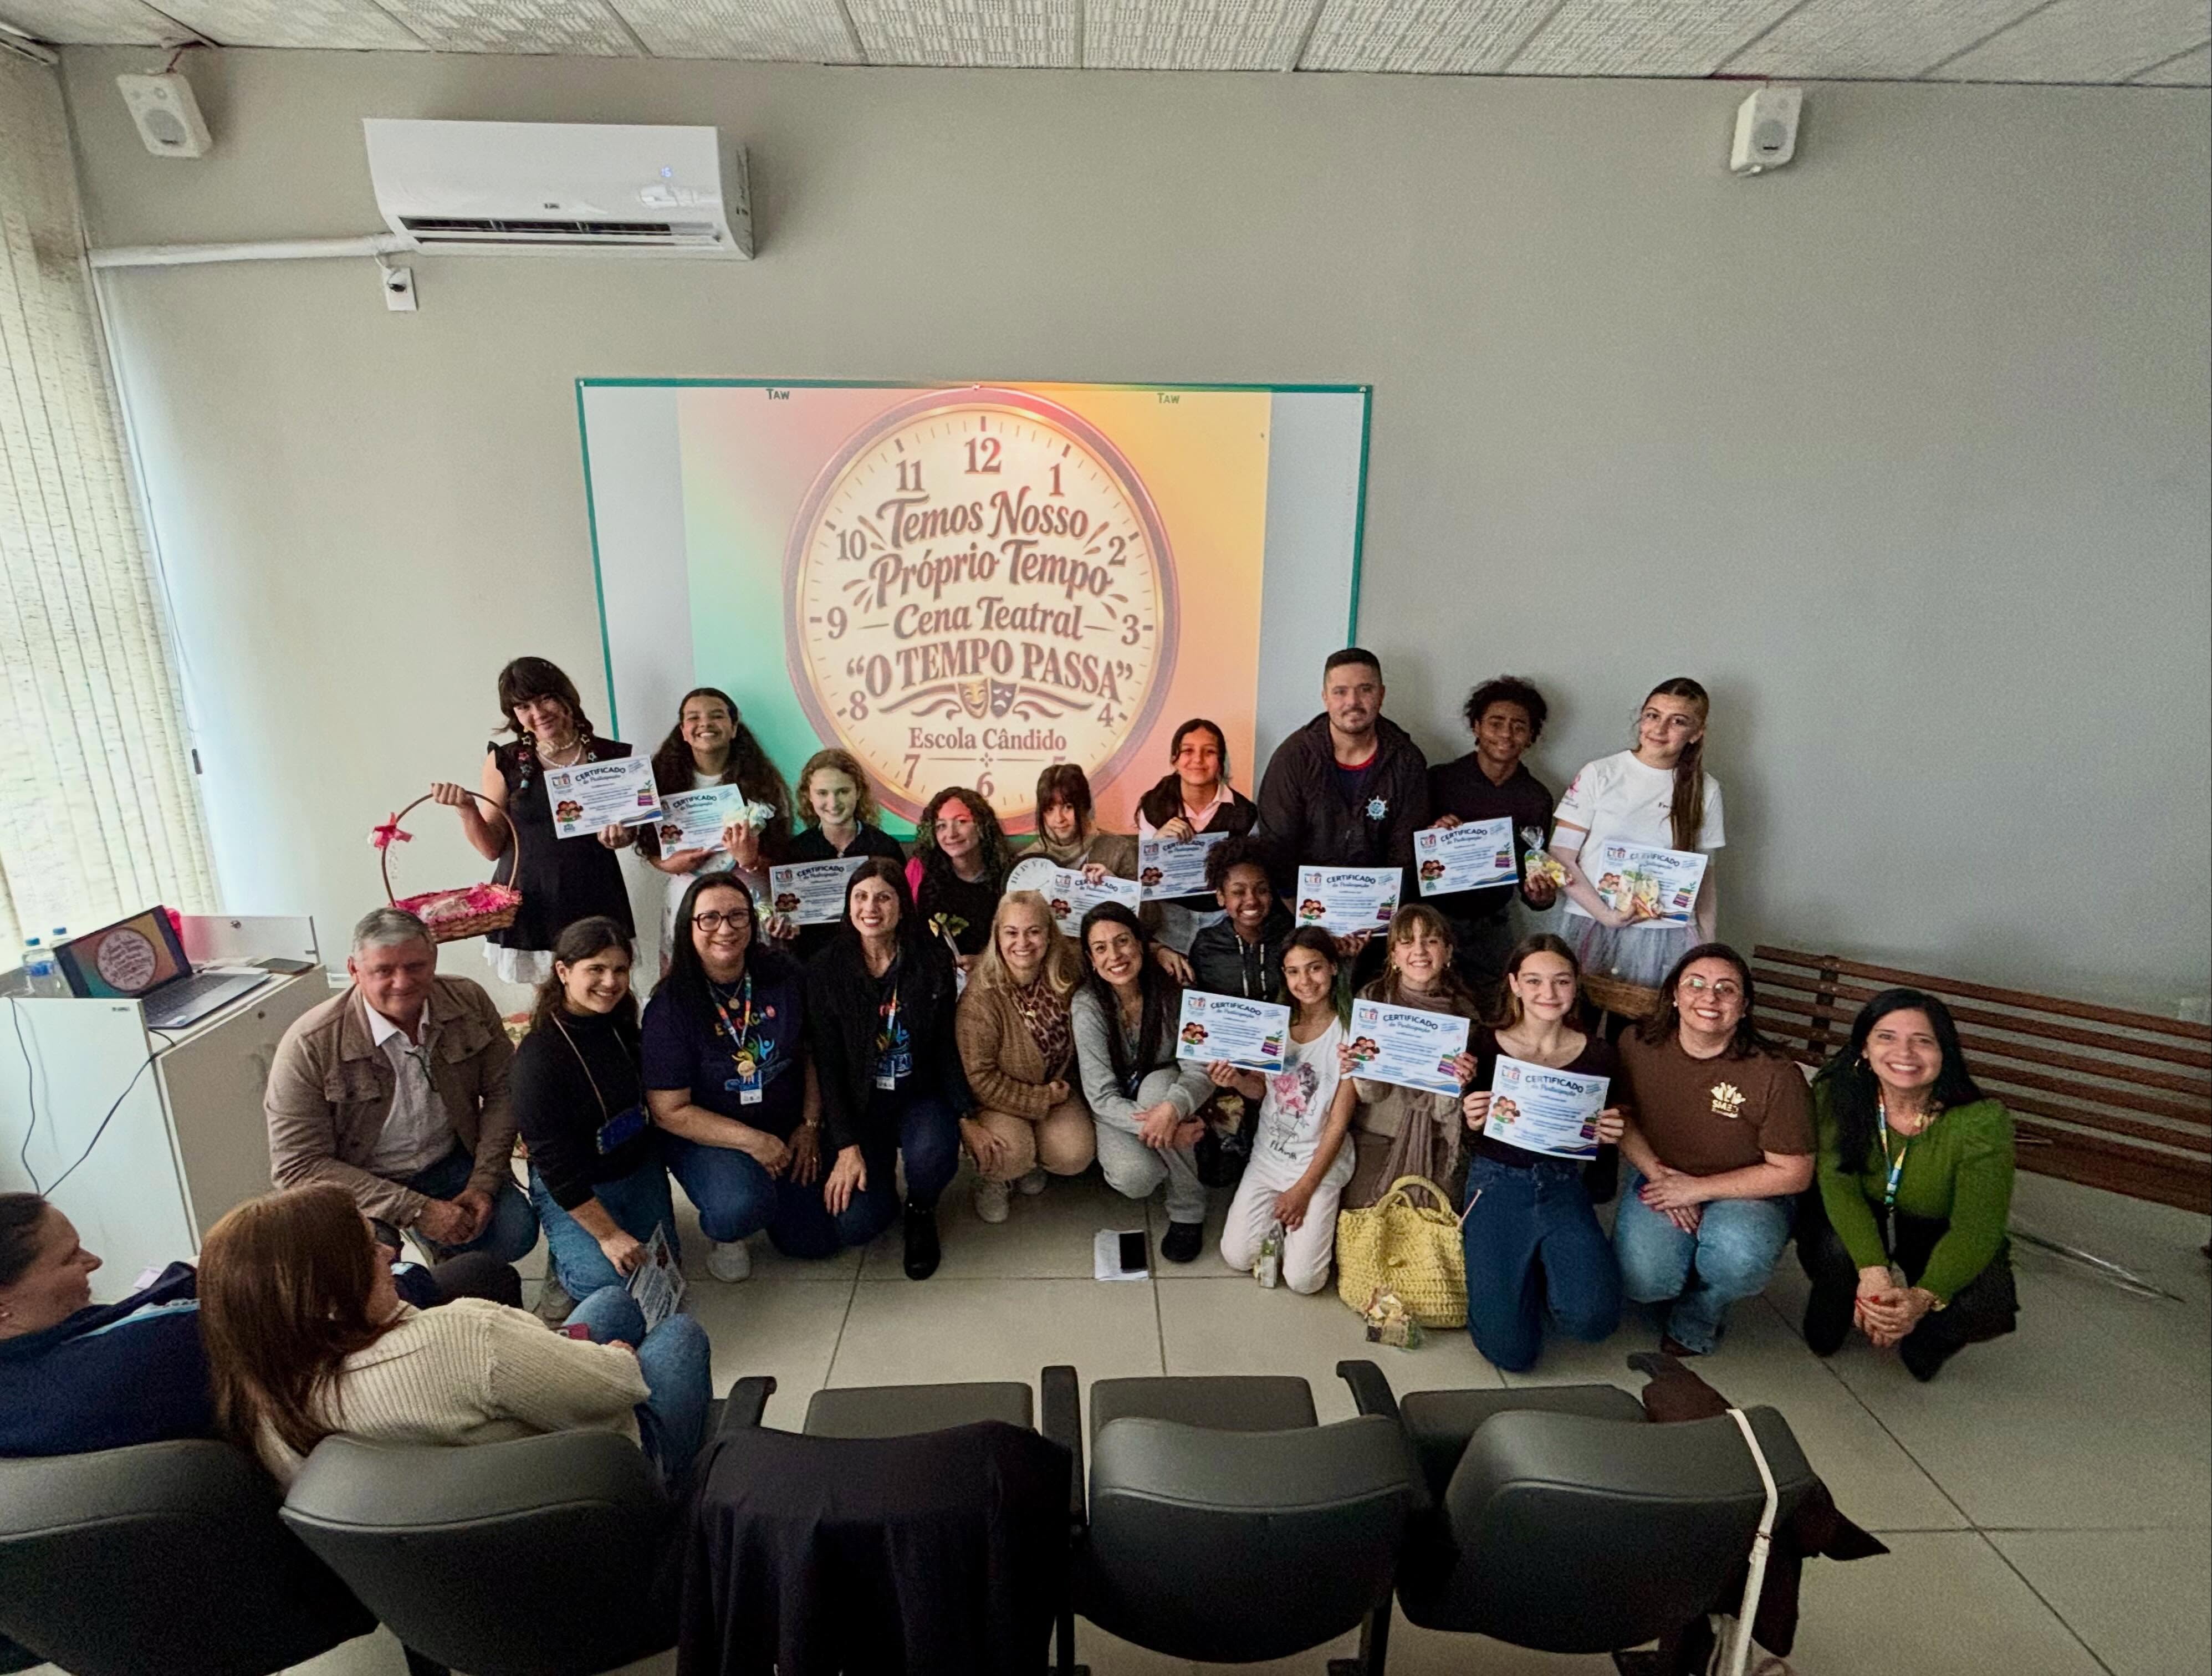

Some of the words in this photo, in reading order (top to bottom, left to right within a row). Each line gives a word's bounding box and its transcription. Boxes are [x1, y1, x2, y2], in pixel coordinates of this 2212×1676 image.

[964, 437, 1002, 474] 12
[896, 460, 926, 492] 11
[1049, 463, 1065, 497] 1
[876, 493, 983, 549] Temos
[987, 486, 1088, 539] Nosso
[836, 529, 867, 561] 10
[1108, 536, 1126, 566] 2
[869, 541, 1000, 609] Próprio
[1000, 539, 1114, 601] Tempo
[827, 606, 847, 639] 9
[893, 604, 972, 640] Cena
[977, 596, 1084, 641] Teatral
[1121, 614, 1140, 645] 3
[896, 638, 1014, 690] TEMPO
[1021, 642, 1133, 704] PASSA”
[849, 691, 869, 721] 8
[1097, 703, 1113, 727] 4
[909, 727, 977, 749] Escola
[983, 728, 1067, 750] Cândido
[575, 767, 626, 781] CERTIFICADO
[903, 754, 921, 789] 7
[977, 771, 994, 798] 6
[673, 795, 717, 808] CERTIFICADO
[1440, 829, 1488, 842] CERTIFICADO
[797, 866, 844, 877] CERTIFICADO
[1326, 875, 1376, 885] CERTIFICADO
[1210, 1002, 1261, 1015] CERTIFICADO
[1383, 1014, 1438, 1030] CERTIFICADO
[1525, 1076, 1584, 1093] CERTIFICADO
